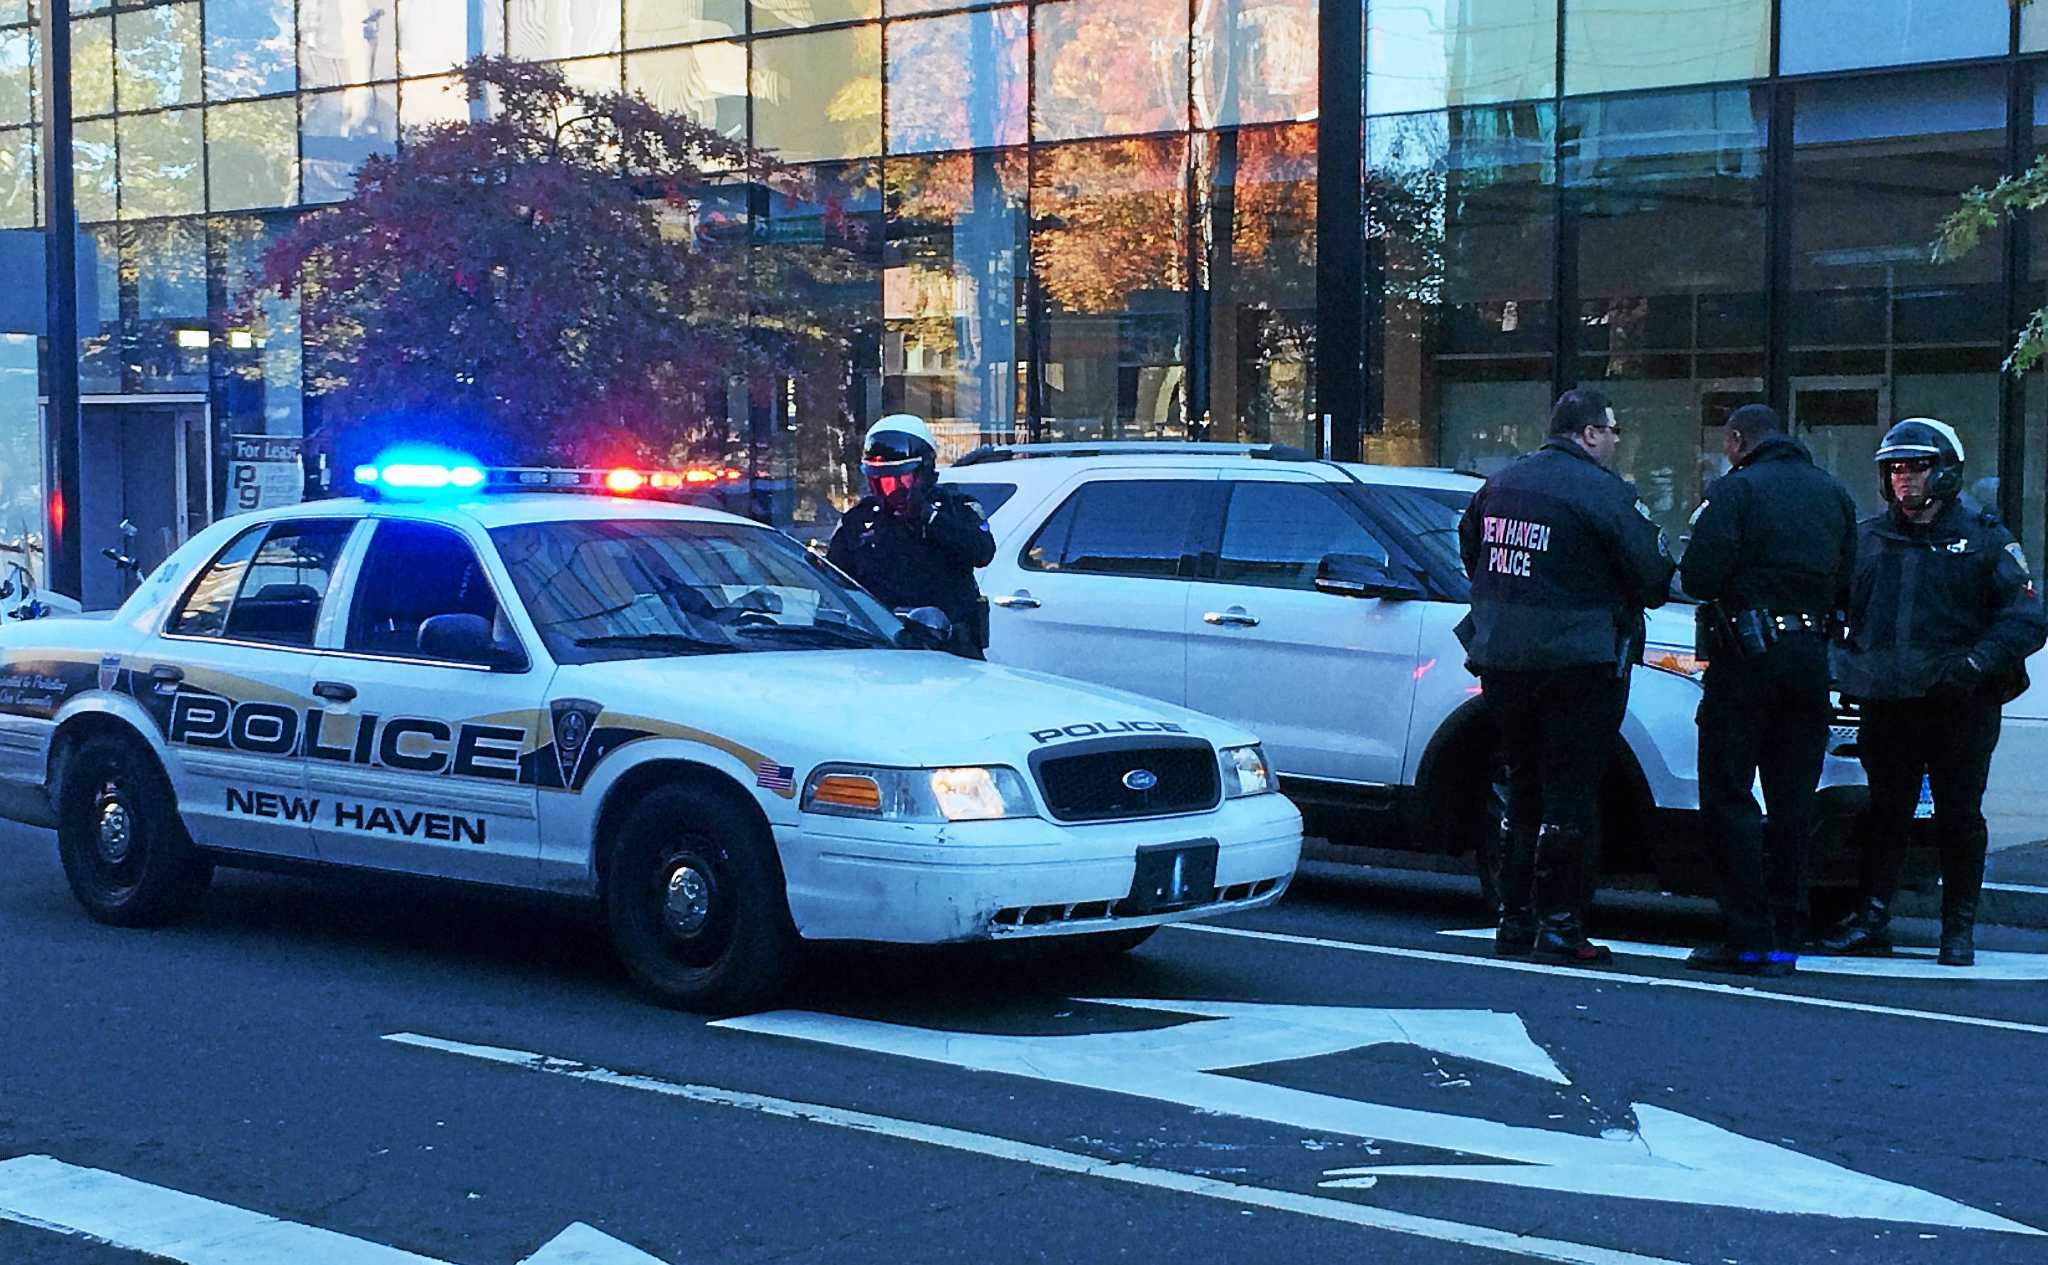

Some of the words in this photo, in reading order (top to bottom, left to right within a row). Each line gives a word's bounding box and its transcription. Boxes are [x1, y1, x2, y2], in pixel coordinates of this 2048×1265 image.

[237, 440, 260, 458] For
[1505, 519, 1551, 551] HAVEN
[1488, 547, 1531, 576] POLICE
[168, 692, 526, 783] POLICE
[1029, 720, 1189, 744] POLICE
[226, 787, 320, 823] NEW
[335, 802, 486, 844] HAVEN
